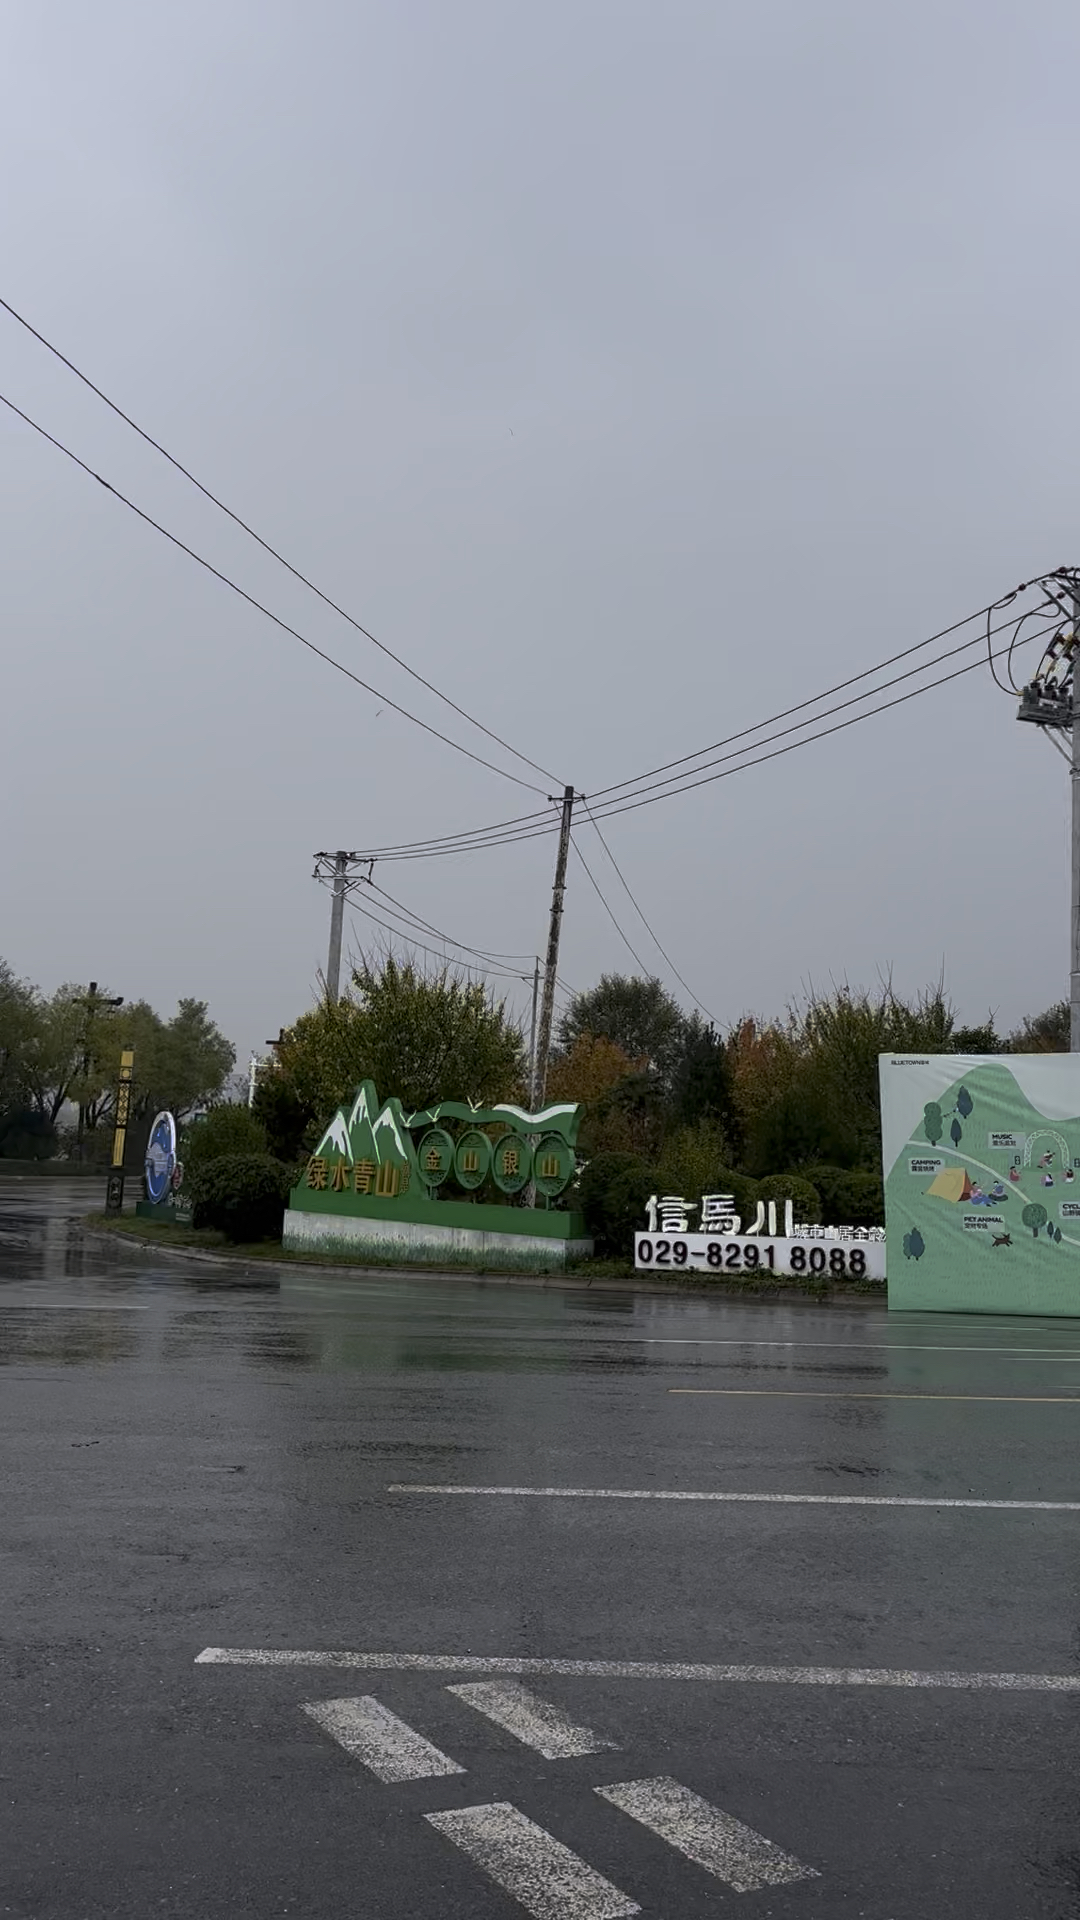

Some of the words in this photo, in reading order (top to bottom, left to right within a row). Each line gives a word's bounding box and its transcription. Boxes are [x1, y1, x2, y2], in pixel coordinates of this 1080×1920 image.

[307, 1155, 400, 1197] 绿水青山
[425, 1147, 560, 1178] 金山银山
[645, 1194, 794, 1238] 信馬川
[638, 1239, 776, 1270] 029-8291
[790, 1246, 866, 1278] 8088
